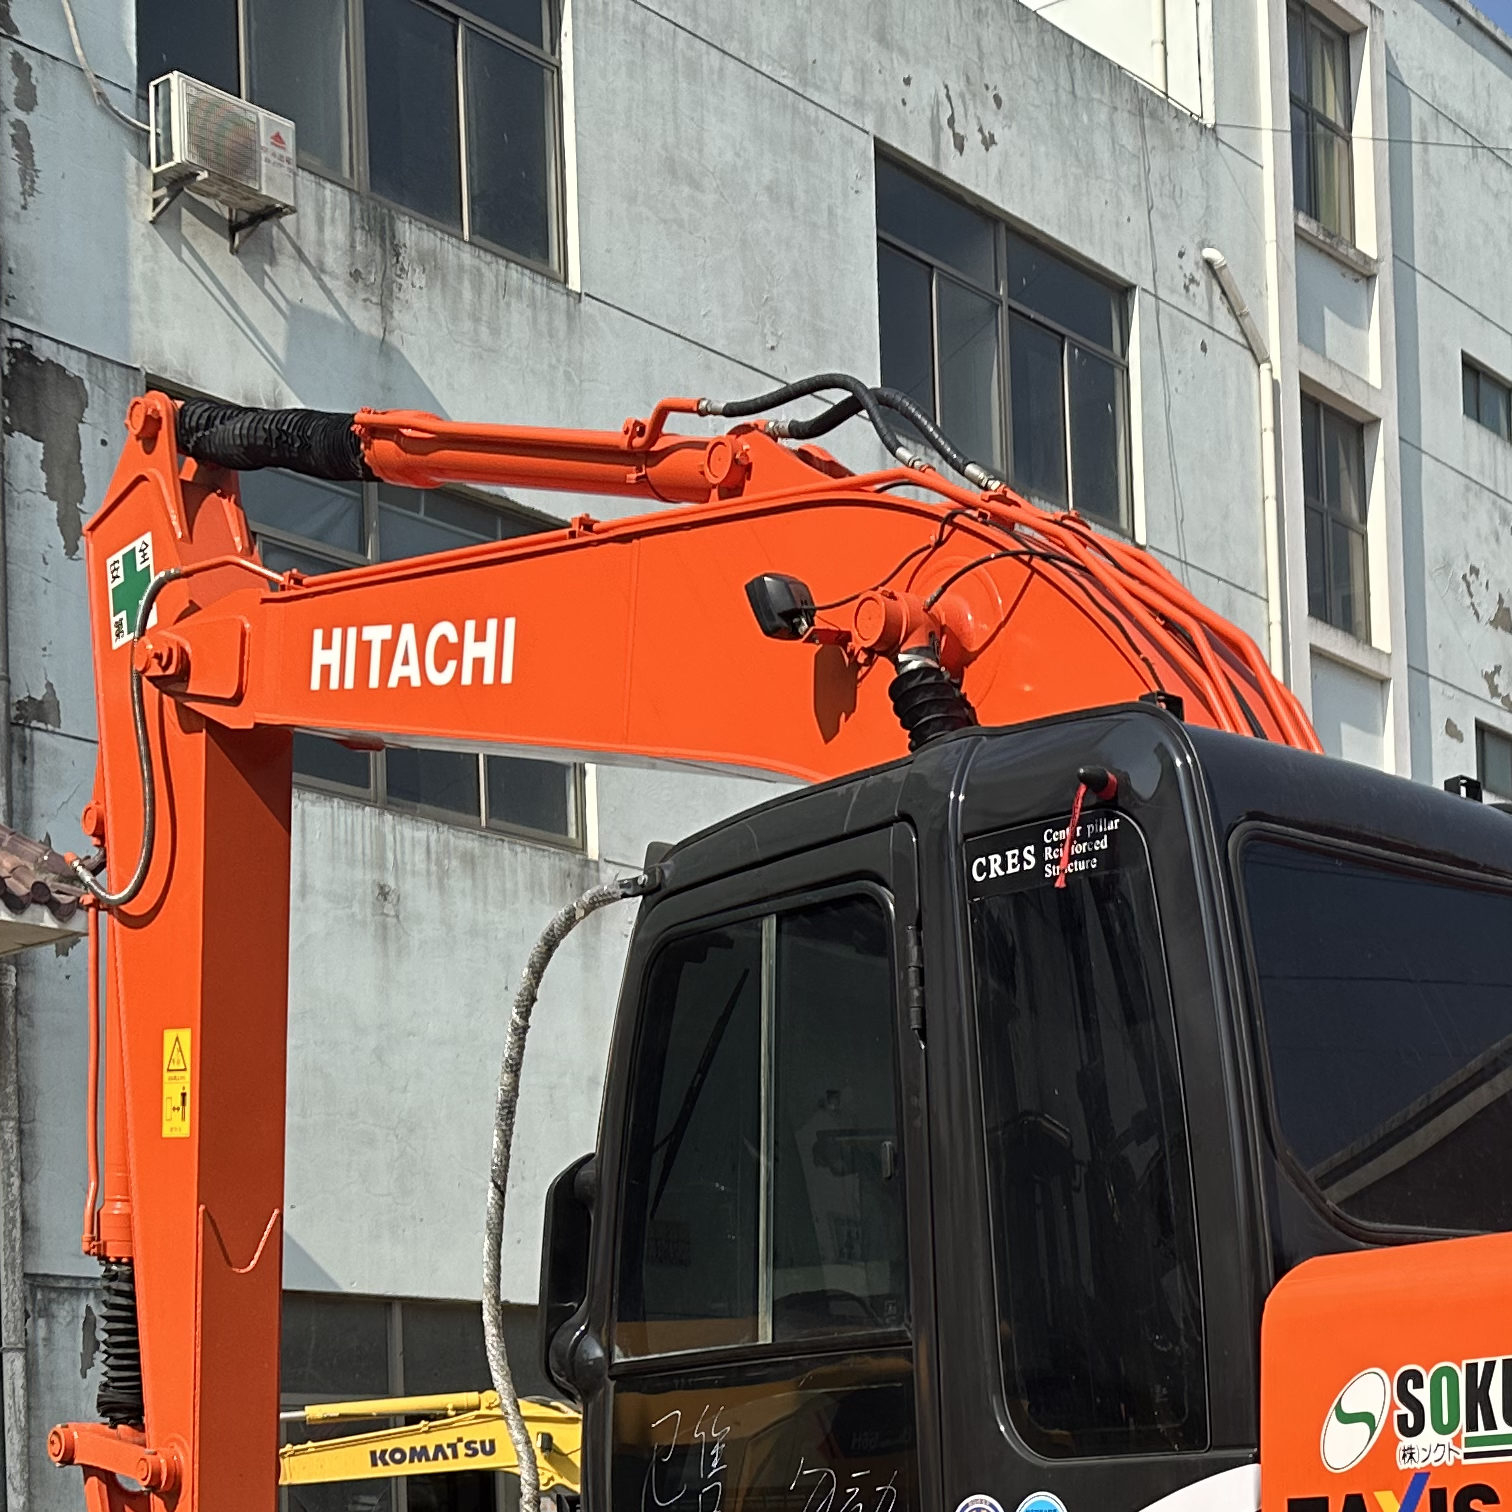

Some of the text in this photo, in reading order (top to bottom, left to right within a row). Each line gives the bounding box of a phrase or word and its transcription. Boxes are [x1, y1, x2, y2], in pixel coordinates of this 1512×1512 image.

[310, 616, 516, 691] HITACHI
[1086, 818, 1120, 838] pillar
[971, 844, 1036, 882] CRES
[1044, 834, 1108, 862] Reiforced
[1044, 857, 1098, 878] Strcture
[369, 1436, 497, 1468] KOMATSU
